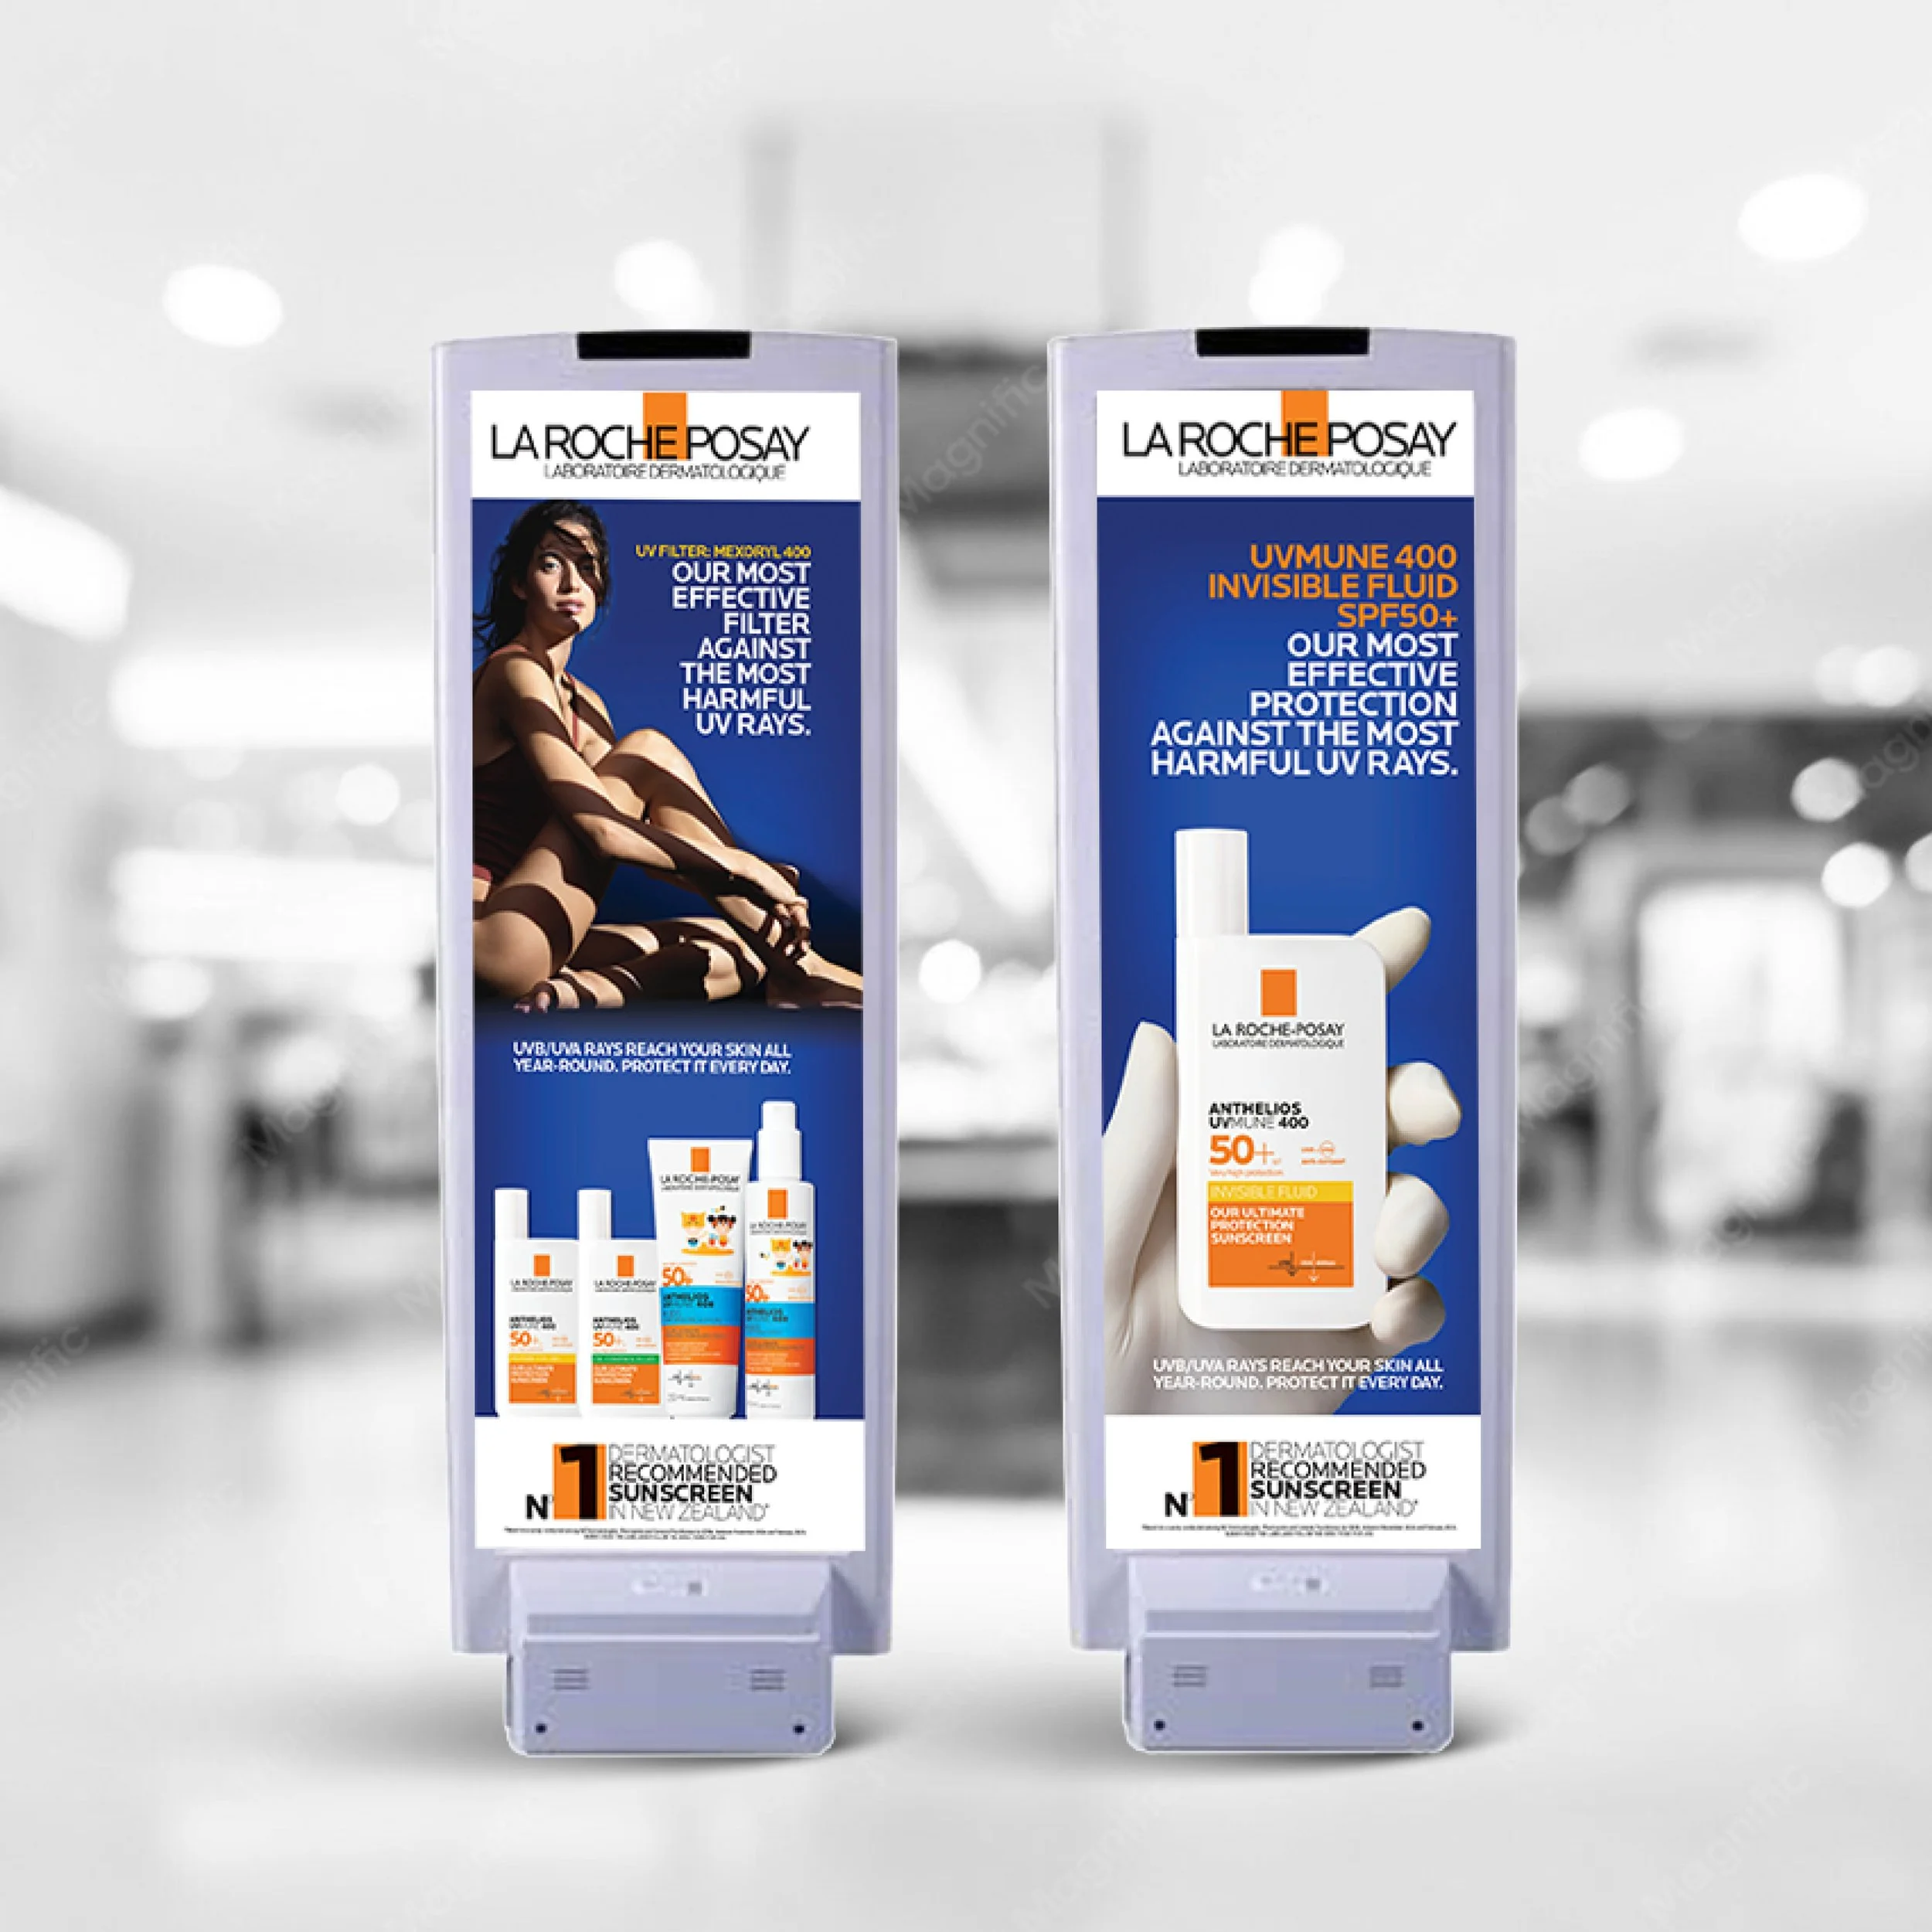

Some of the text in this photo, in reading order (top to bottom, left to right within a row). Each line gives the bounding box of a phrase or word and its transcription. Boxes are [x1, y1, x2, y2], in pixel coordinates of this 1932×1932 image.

[491, 423, 811, 461] LA ROCHE POSAY
[1123, 421, 1458, 457] LA ROCHE POSAY
[544, 464, 786, 482] LABORATOIRE DERMATOLOGIQUE
[1179, 461, 1431, 479] LABORATOIRE DERMATOLOGIQUE
[635, 545, 811, 557] UV FILTER: MEXORYL 400
[1250, 544, 1458, 569] UVMUNE 400
[672, 561, 811, 584] OUR MOST
[1209, 573, 1458, 599] INVISIBLE FLUID
[672, 587, 811, 609] EFFECTIVE
[723, 612, 811, 634] FILTER
[1337, 603, 1459, 628] SPF50+
[697, 637, 811, 659] AGAINST
[1287, 632, 1459, 657] OUR MOST
[679, 662, 811, 685] THE MOST
[1287, 662, 1458, 686] EFFECTIVE
[682, 688, 811, 710] HARMFUL
[1250, 692, 1458, 716] PROTECTION
[696, 713, 811, 736] UV RAYS.
[1151, 721, 1459, 747] AGAINST THE MOST
[1151, 750, 1459, 776] HARMFUL UV RAYS.
[1211, 1022, 1345, 1036] LA ROCHE-POSAY
[512, 1041, 791, 1058] UVB/UVA RAYS REACH YOUR SKIN ALL
[512, 1058, 791, 1074] YEAR-ROUND. PROTECT IT EVERY DAY.
[1208, 1101, 1302, 1116] ANTHELIOS
[1209, 1116, 1309, 1129] UVMUNE 400
[1209, 1185, 1318, 1199] INVISIBLE FLUID
[1209, 1206, 1304, 1219] OUR ULTIMATE
[1209, 1219, 1294, 1232] PROTECTION
[1210, 1233, 1293, 1245] SUNSCREEN
[1153, 1358, 1444, 1372] UVB/UVA RAYS REACH YOUR SKIN ALL
[1153, 1376, 1444, 1390] YEAR-ROUND. PROTECT IT EVERY DAY.
[608, 1443, 777, 1464] DERMATOLOGIST
[1250, 1440, 1424, 1461] DERMATOLOGIST
[608, 1464, 778, 1484] RECOMMENDED
[1199, 1440, 1240, 1518] 1
[1250, 1461, 1428, 1480] RECOMMENDED
[560, 1443, 598, 1520] 1
[1250, 1479, 1402, 1499] SUNSCREEN
[608, 1483, 754, 1503] SUNSCREEN
[609, 1503, 626, 1522] IN
[631, 1503, 677, 1522] NEW
[1250, 1499, 1268, 1518] IN
[1274, 1499, 1320, 1518] NEW
